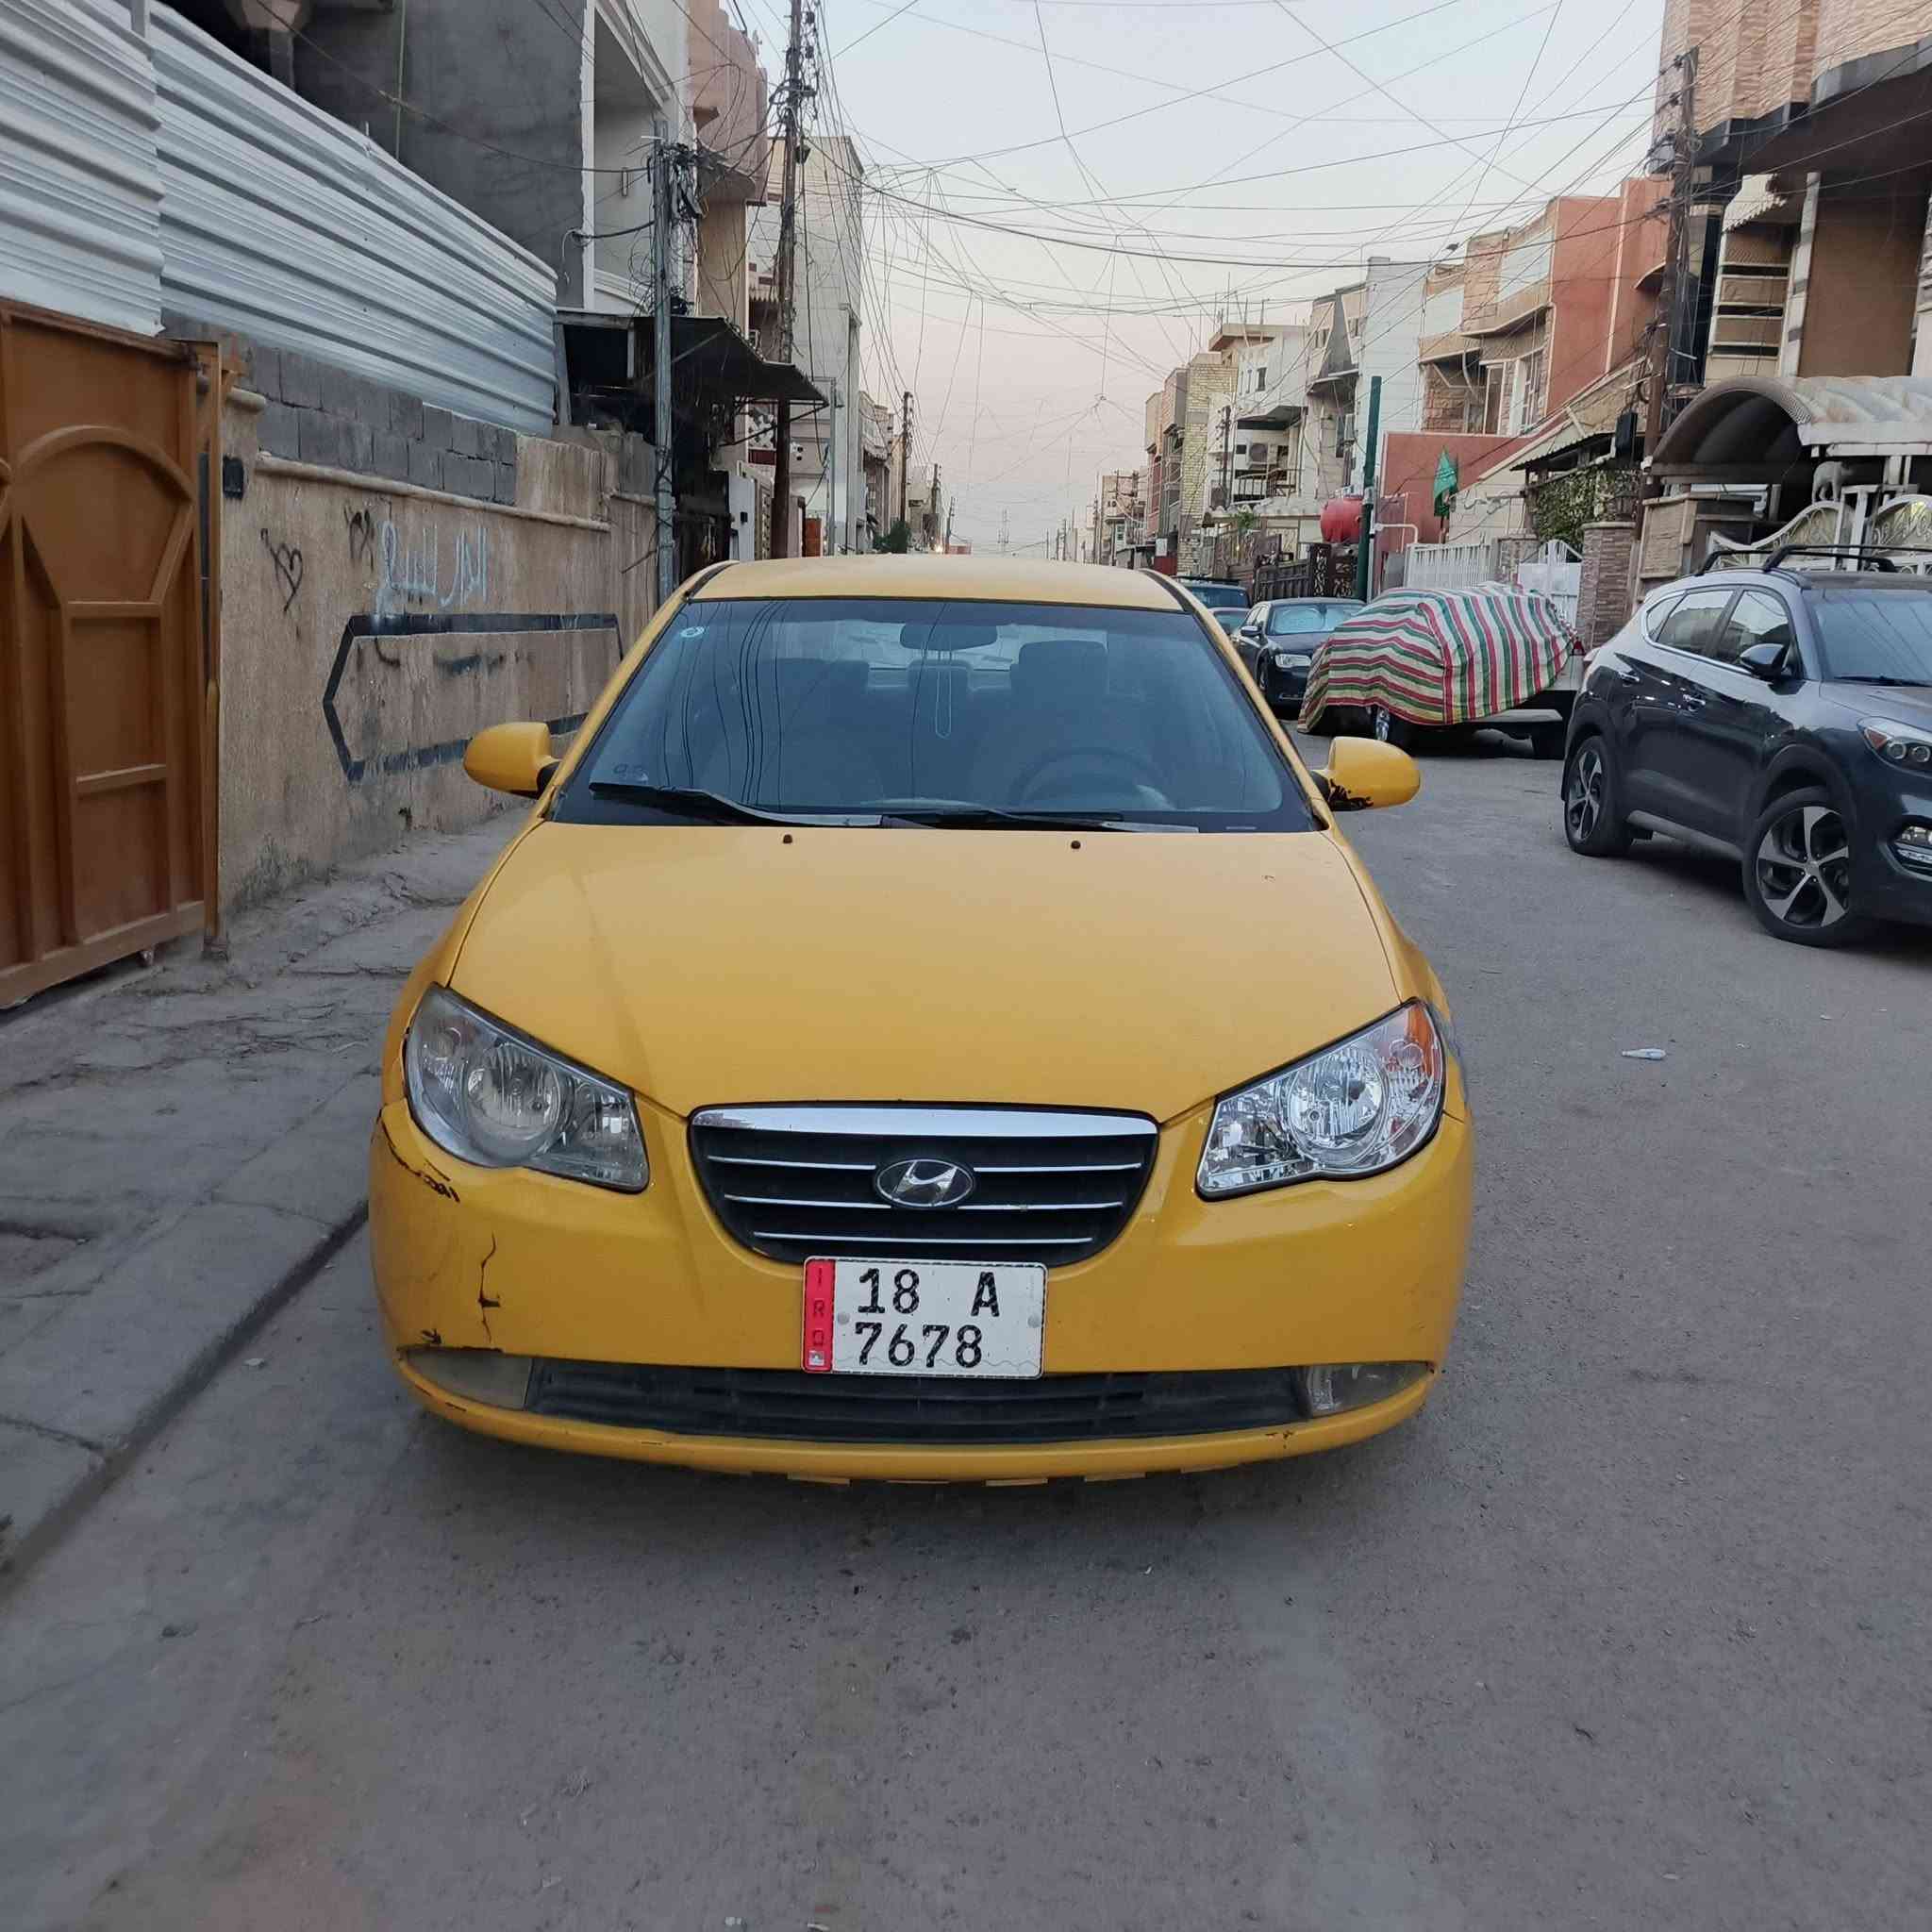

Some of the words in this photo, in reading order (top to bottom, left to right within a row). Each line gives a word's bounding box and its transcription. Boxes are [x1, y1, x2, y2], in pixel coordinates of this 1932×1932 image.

[858, 1268, 920, 1314] 18
[971, 1272, 1000, 1317] A
[855, 1321, 983, 1368] 7678
